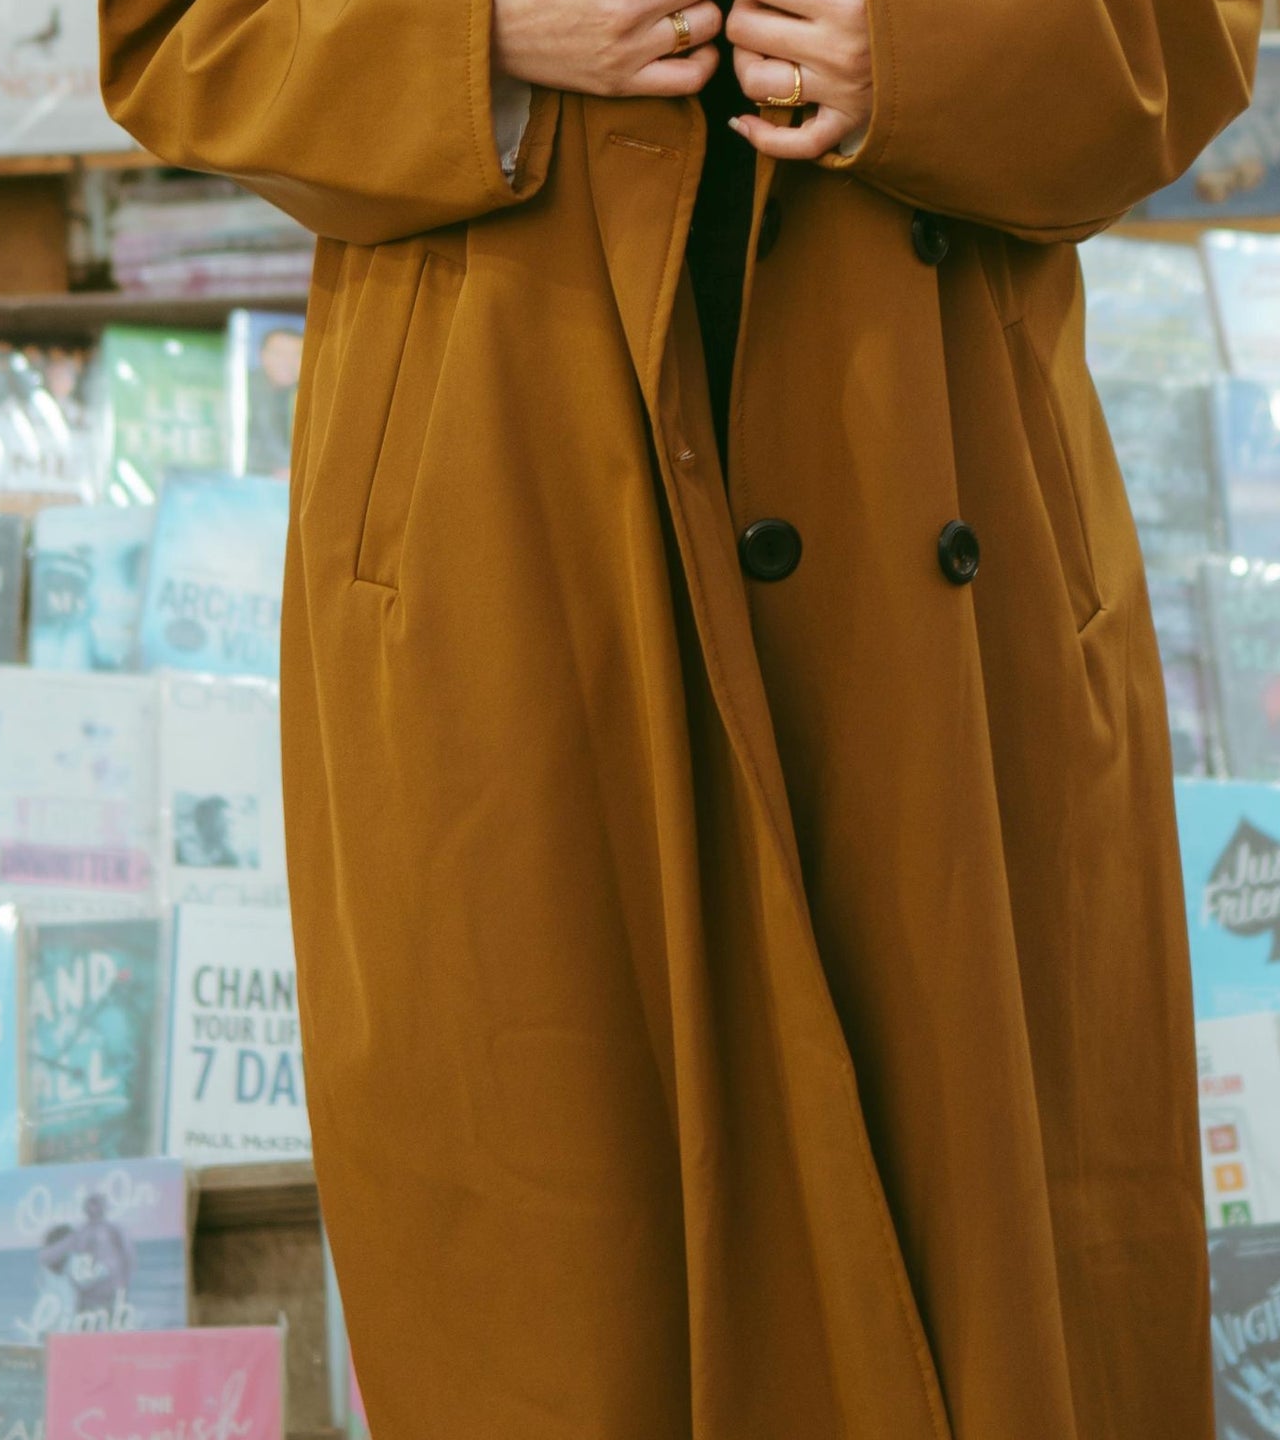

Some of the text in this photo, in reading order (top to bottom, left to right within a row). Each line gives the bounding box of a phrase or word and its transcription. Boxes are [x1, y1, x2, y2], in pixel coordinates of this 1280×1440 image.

[191, 964, 293, 1012] CHAN
[191, 1015, 256, 1044] YOUR
[190, 1046, 300, 1107] 7 DA
[185, 1130, 235, 1148] PAUL
[16, 1167, 161, 1235] Out On
[135, 1394, 175, 1416] THE
